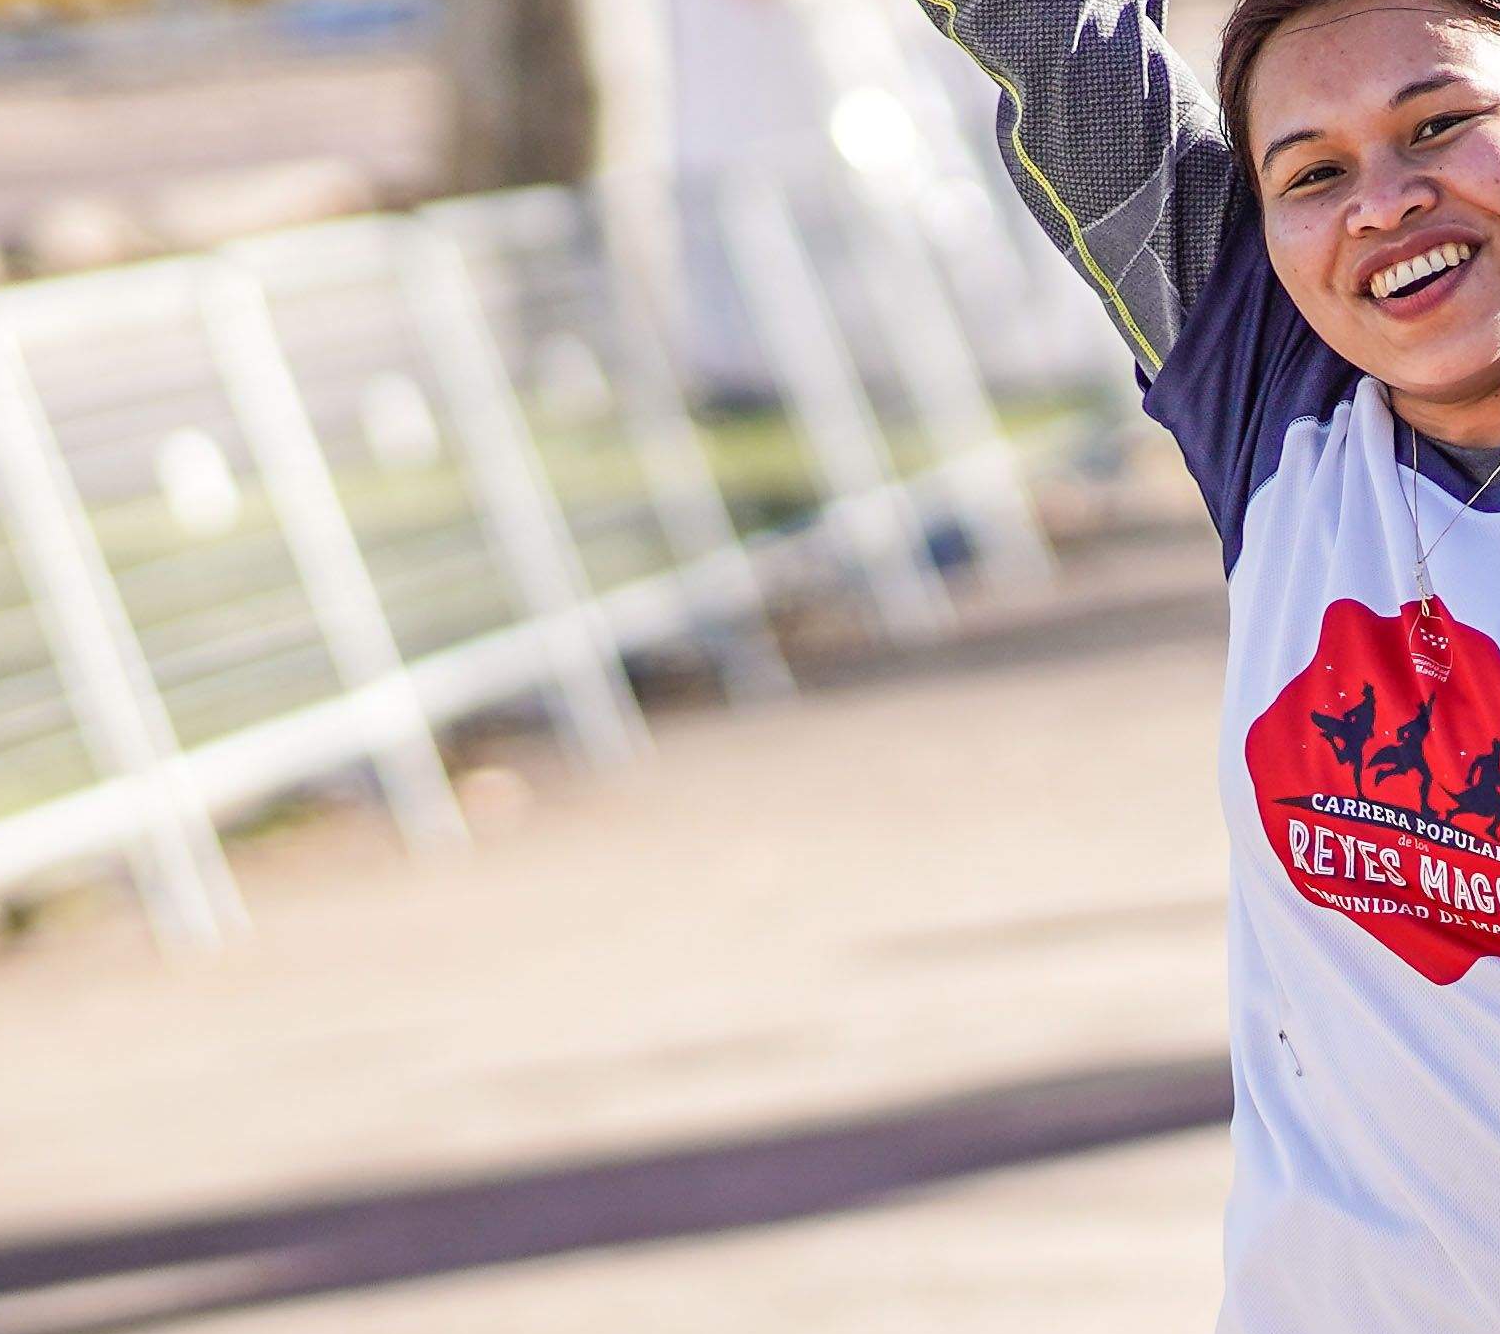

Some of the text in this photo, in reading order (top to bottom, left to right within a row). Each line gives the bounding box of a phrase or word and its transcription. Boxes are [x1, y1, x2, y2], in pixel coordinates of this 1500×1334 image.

[1311, 793, 1411, 830] CARRERA
[1288, 818, 1407, 887] REYES
[1398, 834, 1412, 848] de
[1303, 881, 1430, 919] MUNIDAD
